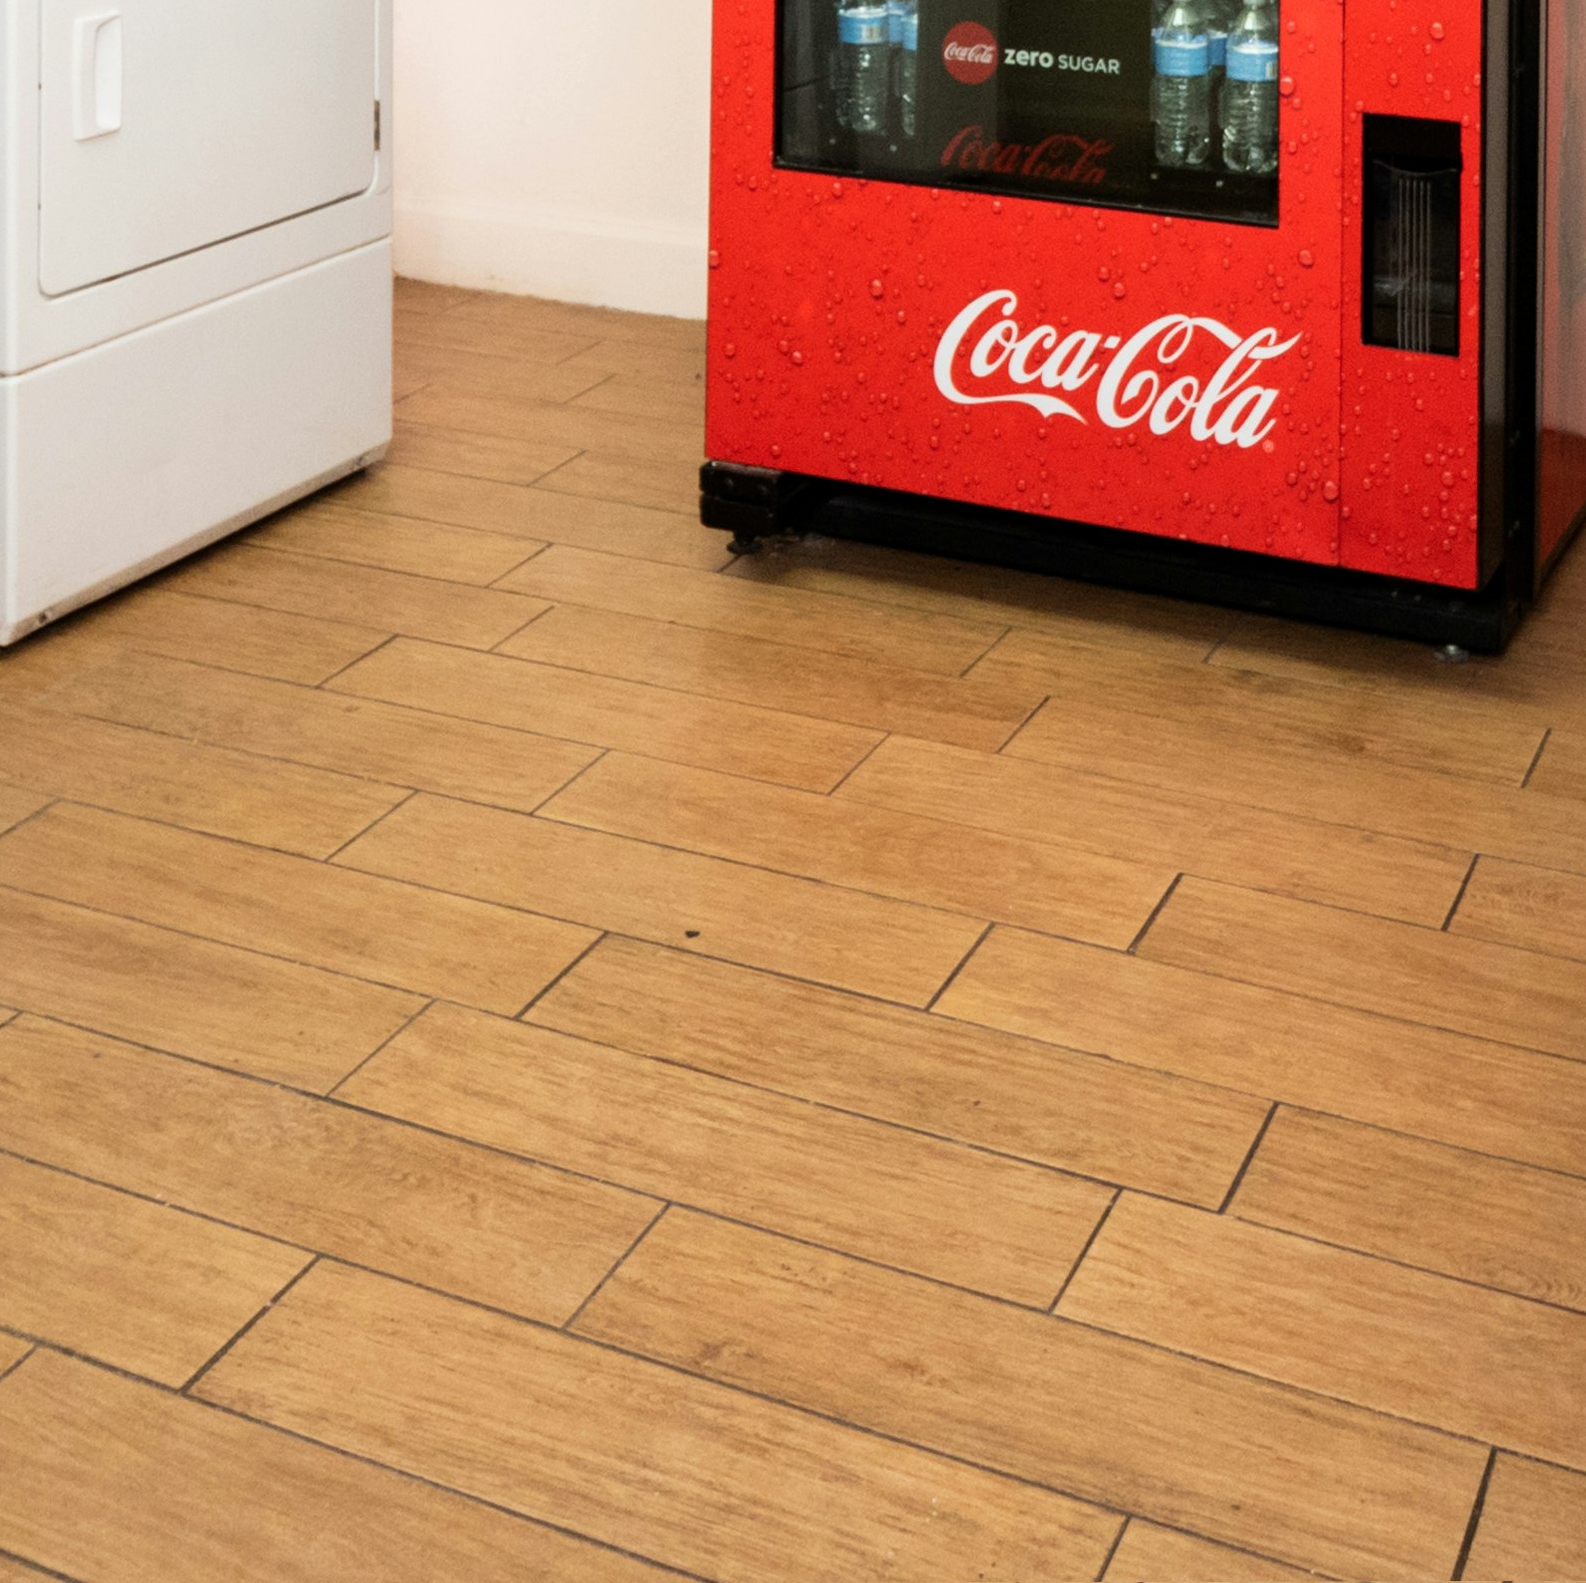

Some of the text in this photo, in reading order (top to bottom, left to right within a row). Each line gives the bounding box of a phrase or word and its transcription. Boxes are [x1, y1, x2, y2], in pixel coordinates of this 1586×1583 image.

[1004, 49, 1054, 68] zero
[1058, 54, 1120, 75] SUGAR
[934, 289, 1302, 448] Coca-Cola
